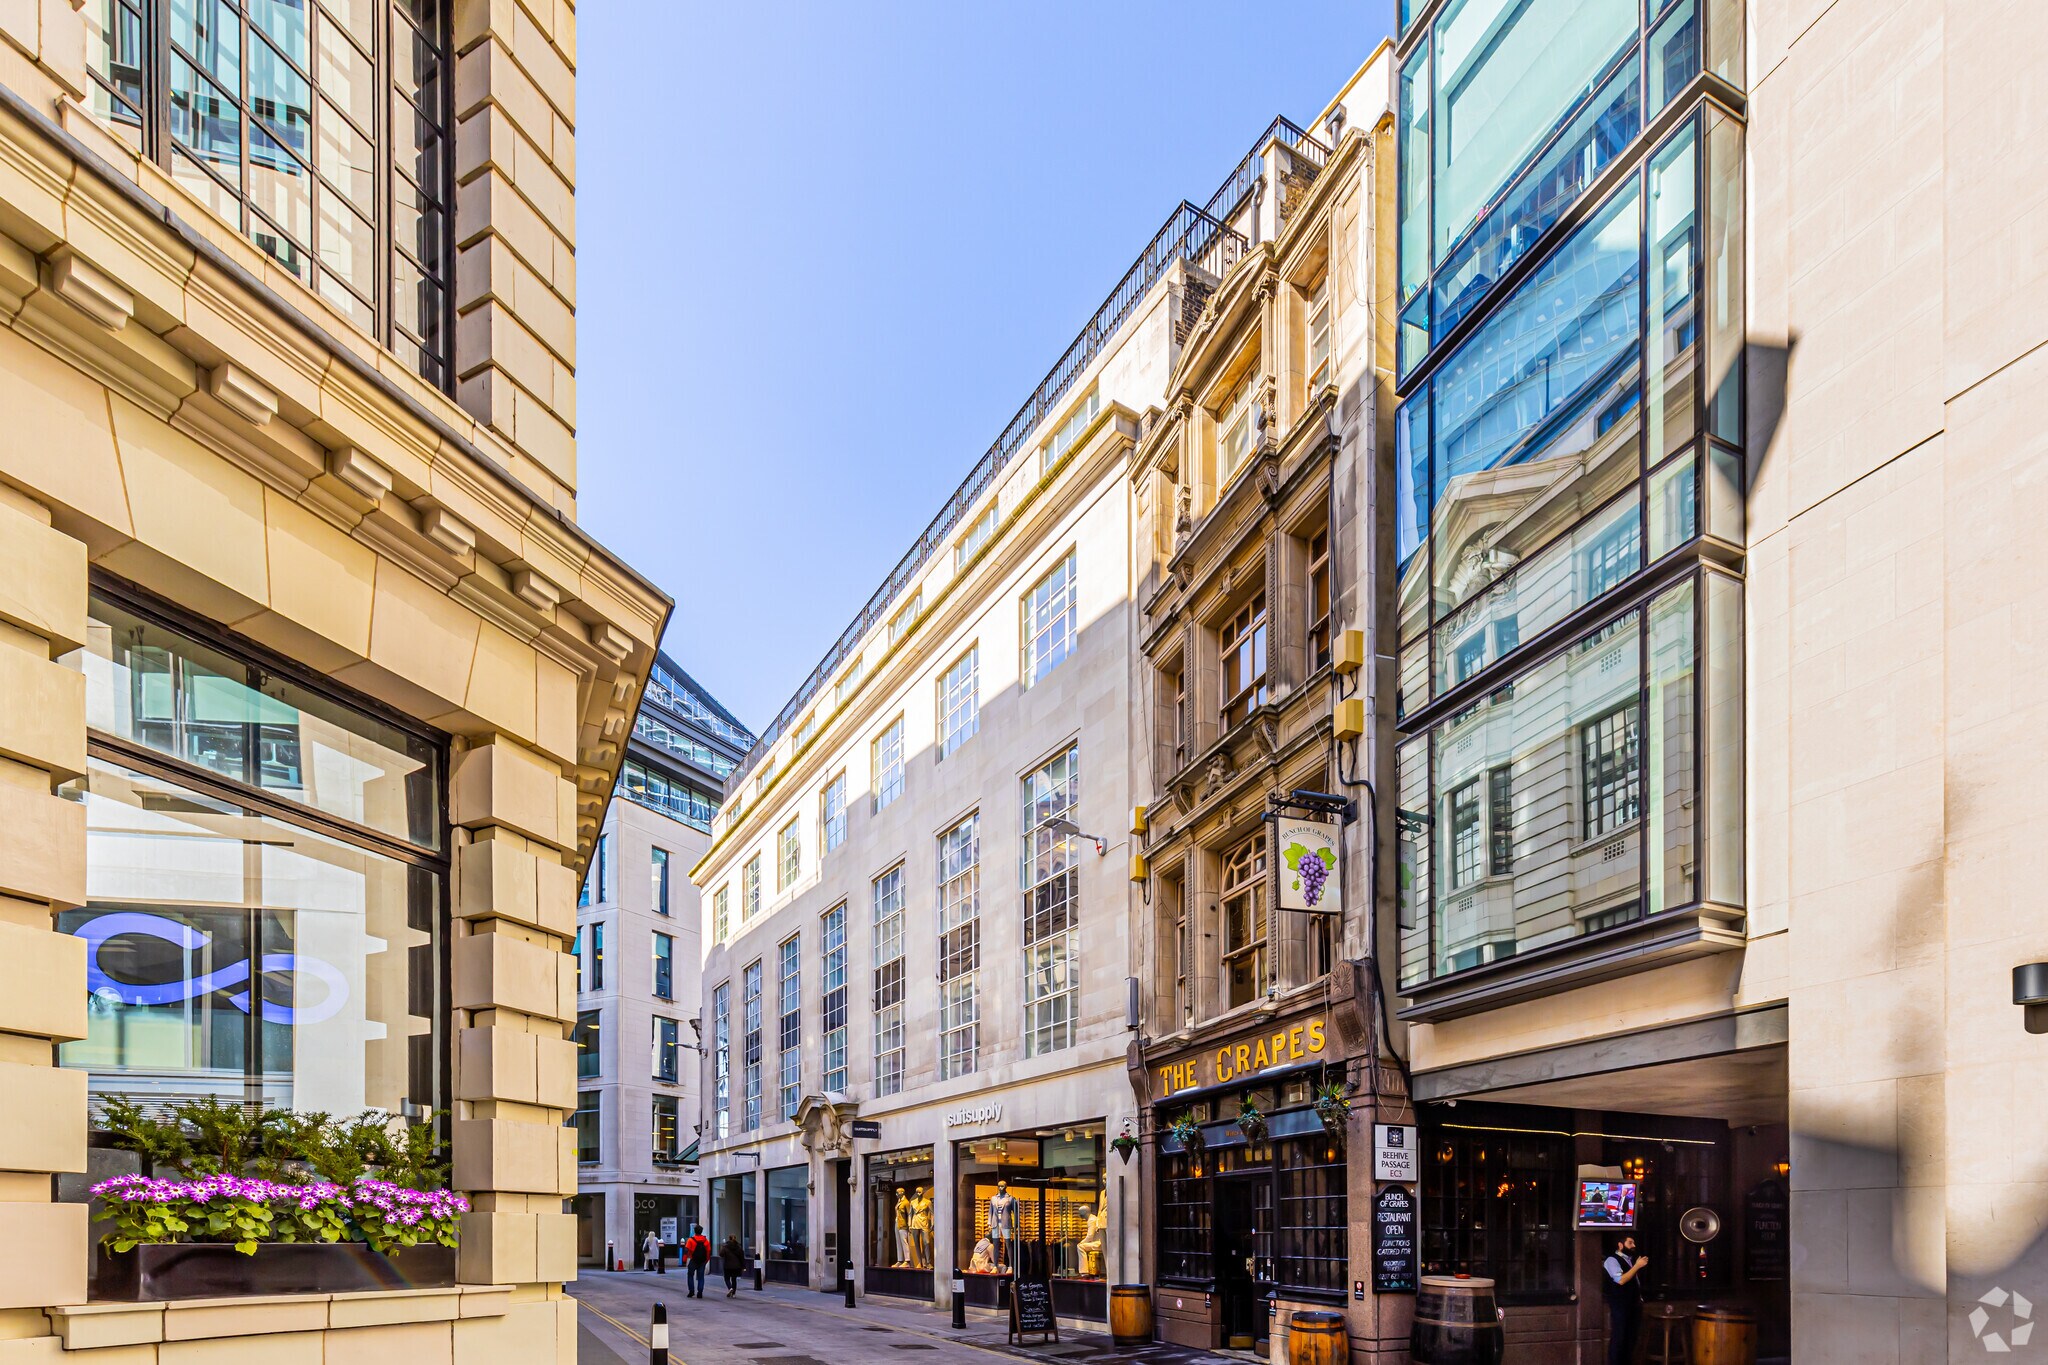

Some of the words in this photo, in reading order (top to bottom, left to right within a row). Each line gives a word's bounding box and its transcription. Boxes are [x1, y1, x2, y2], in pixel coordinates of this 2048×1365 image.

[1282, 826, 1303, 840] BUNCH
[1311, 828, 1335, 847] GRAPES
[1159, 1059, 1198, 1097] THE
[1216, 1020, 1327, 1083] GRAPES
[947, 1101, 1003, 1127] suitsupply
[1382, 1151, 1409, 1160] BEEHIVE
[1381, 1160, 1411, 1169] PASSAGE
[1390, 1169, 1403, 1178] EC3
[1384, 1193, 1404, 1201] BUNCH
[1379, 1200, 1389, 1208] OF
[1389, 1200, 1410, 1208] GRAPES
[1377, 1212, 1412, 1223] RESTAURANT
[1385, 1224, 1404, 1235] OPEN
[1381, 1239, 1411, 1247] FUNCTIONS
